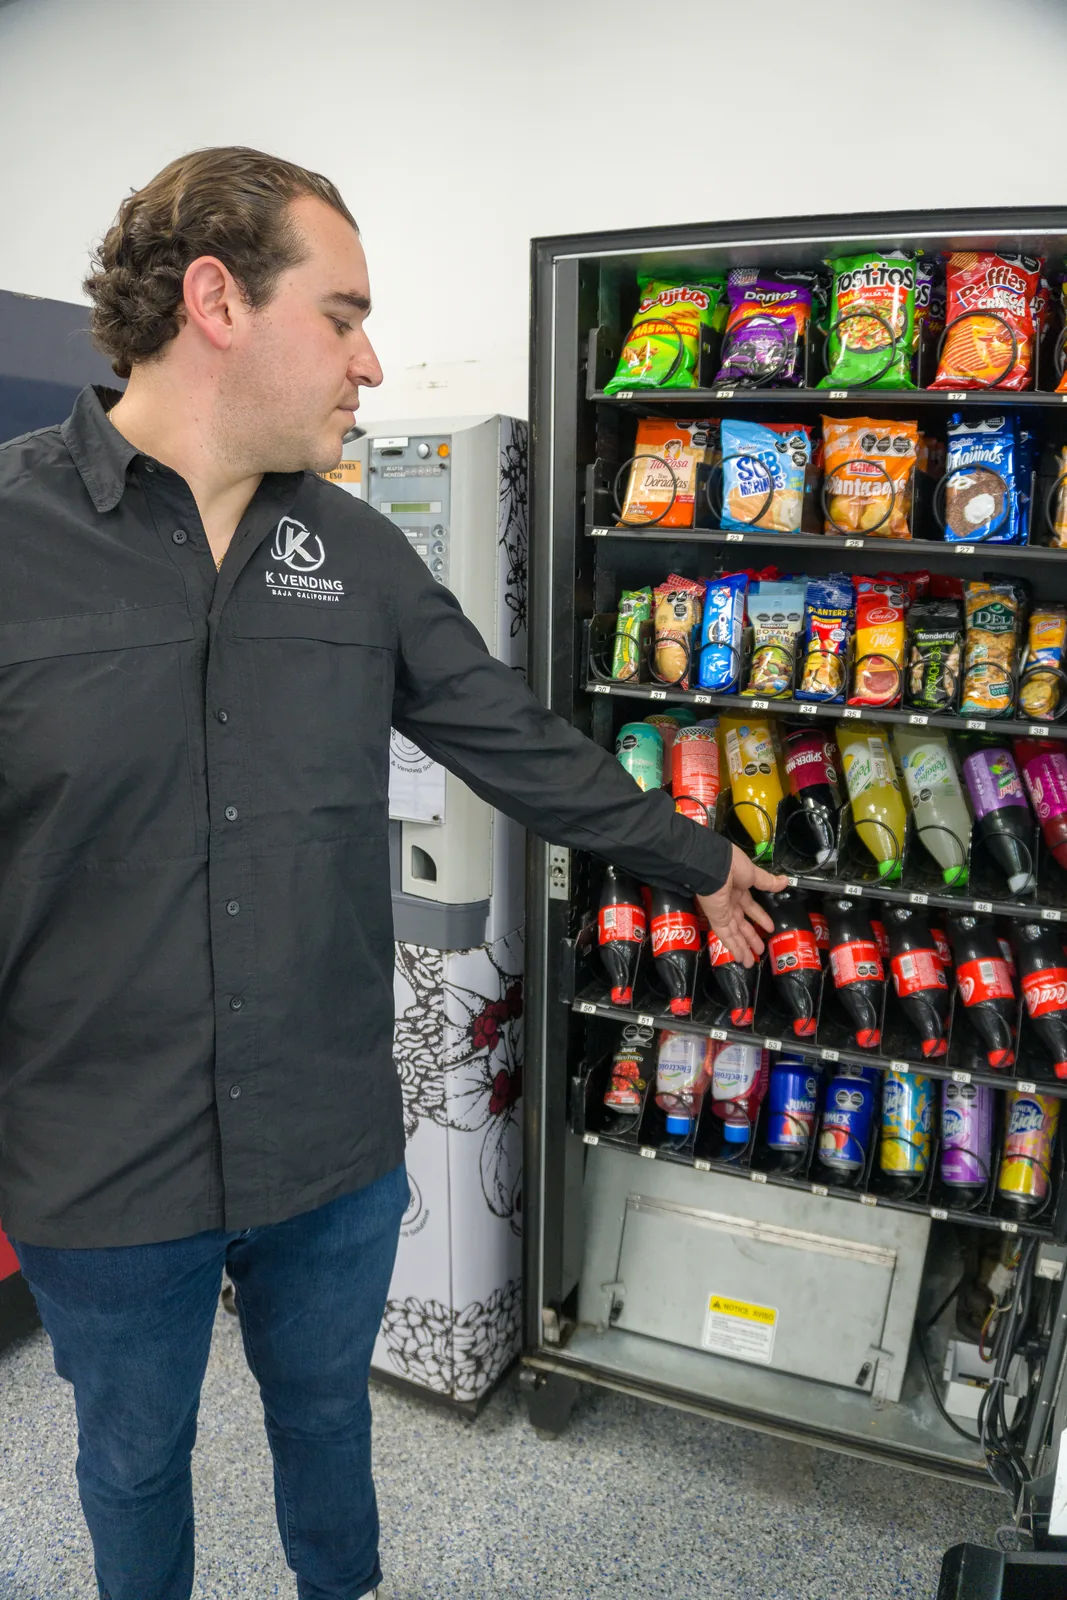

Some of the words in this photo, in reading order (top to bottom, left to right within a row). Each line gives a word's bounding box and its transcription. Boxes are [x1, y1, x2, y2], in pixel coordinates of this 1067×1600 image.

[744, 290, 798, 302] Doritos
[329, 472, 343, 480] USO
[644, 475, 689, 488] Doradtas
[740, 475, 785, 496] MARINS
[825, 476, 907, 496] Mantecads
[265, 570, 275, 583] K
[278, 573, 344, 591] VENDING
[272, 589, 292, 597] BAJA
[296, 591, 340, 602] CALIFORNIA
[757, 629, 797, 638] BOTANA
[918, 632, 955, 640] Wonderful
[925, 646, 941, 701] PISTACHOS
[913, 716, 924, 724] 36
[1033, 727, 1045, 735] 38
[397, 763, 423, 774] Vending
[652, 926, 696, 953] Coca-Co
[583, 1004, 593, 1012] 50
[640, 1016, 650, 1024] 51
[713, 1031, 724, 1039] 52
[767, 1041, 778, 1049] 53
[658, 1063, 692, 1074] Electroli
[714, 1070, 749, 1083] Electroli
[957, 1073, 967, 1081] 56
[1021, 1083, 1032, 1091] 57
[824, 1112, 851, 1124] UMEX
[409, 1208, 430, 1237] Solutions
[723, 1303, 750, 1315] NOTICE
[752, 1310, 775, 1321] AVISO
